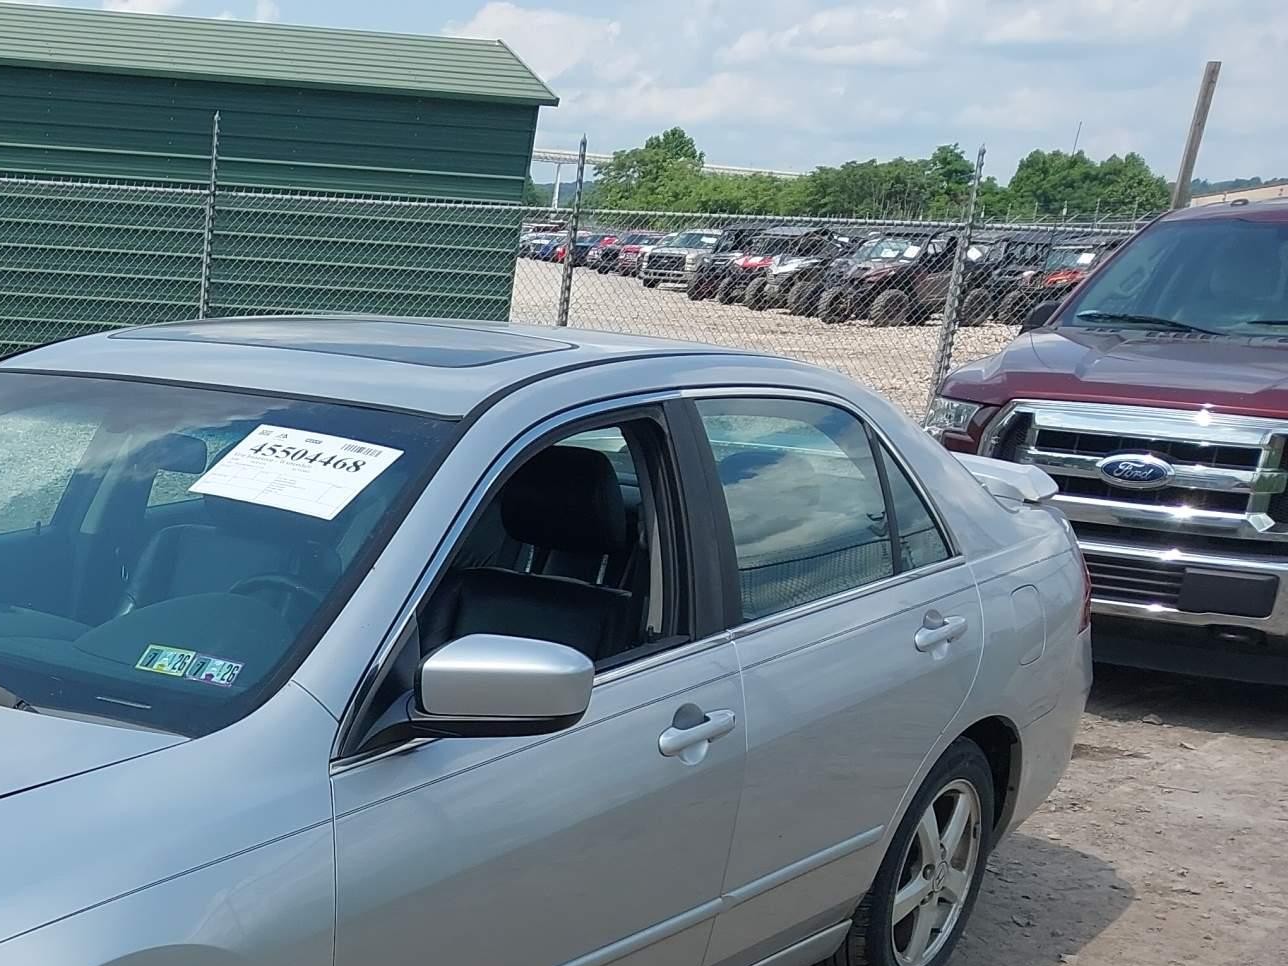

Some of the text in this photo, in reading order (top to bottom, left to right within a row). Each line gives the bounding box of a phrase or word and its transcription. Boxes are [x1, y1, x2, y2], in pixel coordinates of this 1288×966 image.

[249, 441, 367, 473] 45504468
[1112, 461, 1153, 481] Ford
[144, 652, 191, 672] 7 26
[193, 661, 240, 683] 7 26
